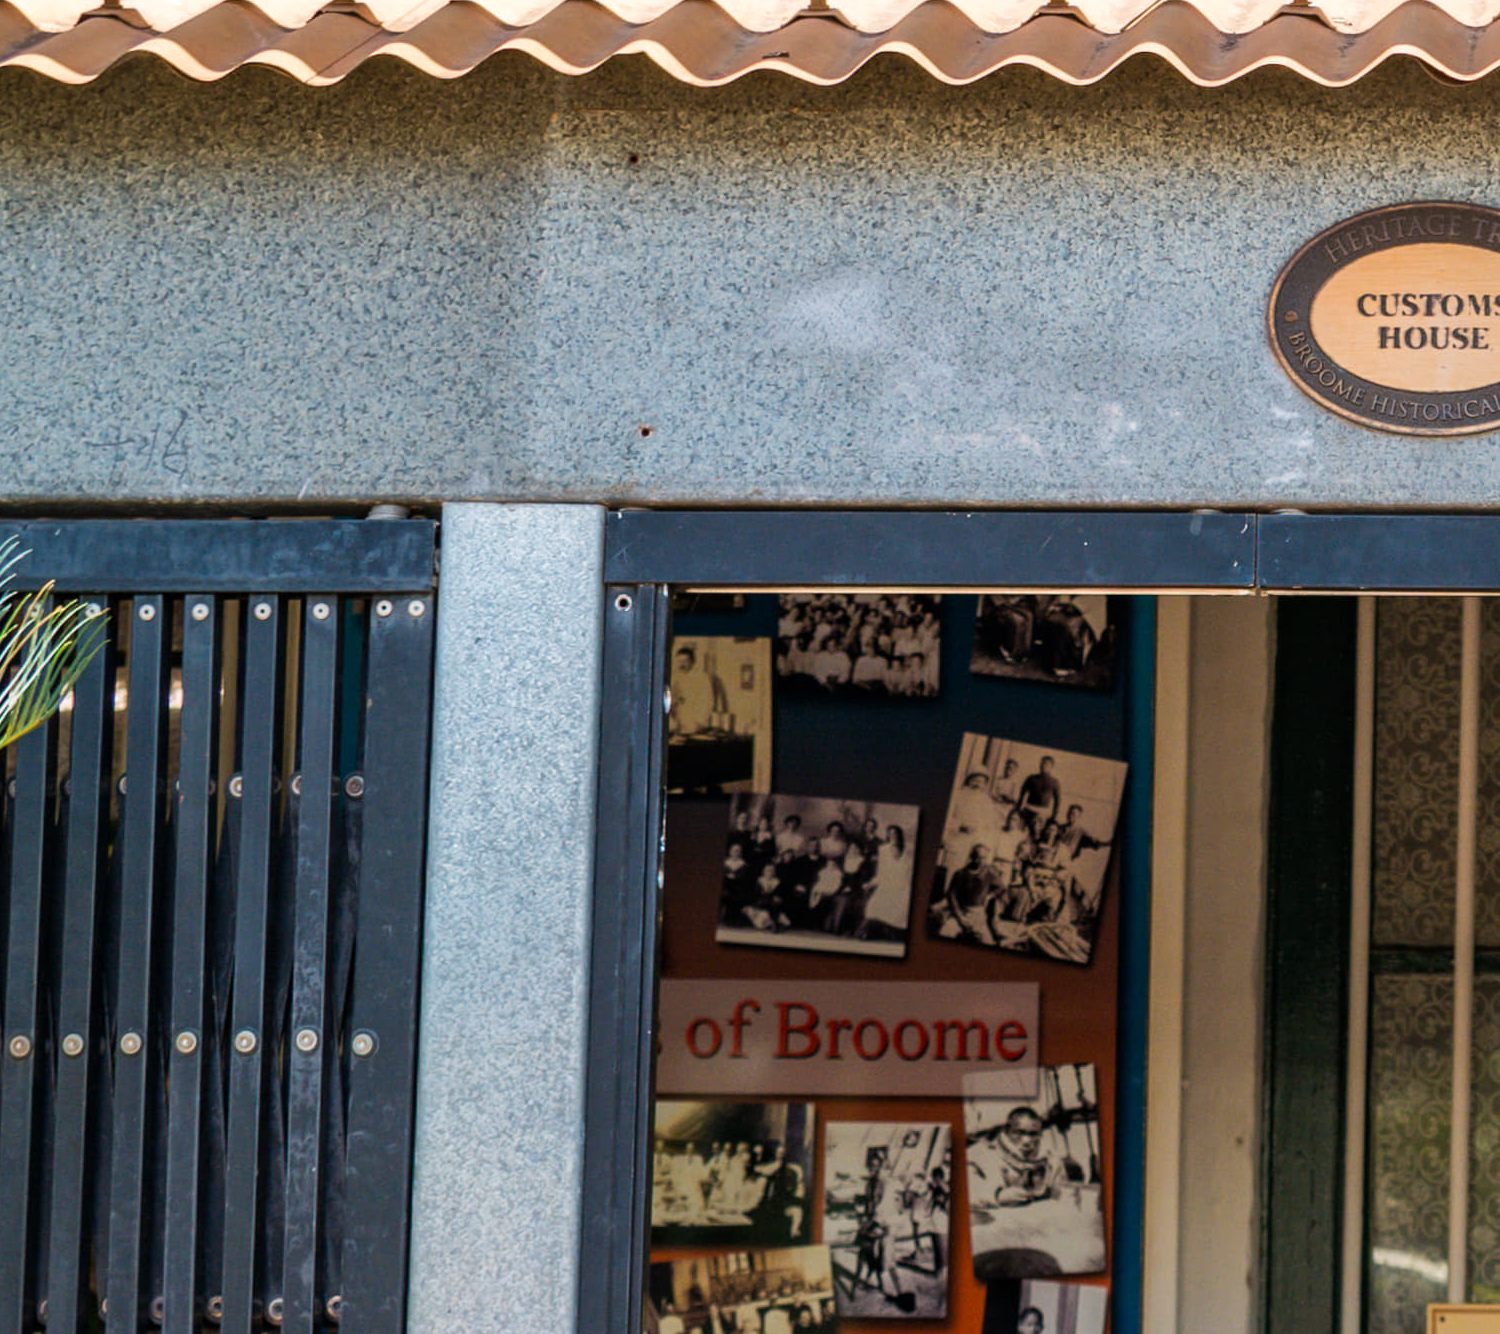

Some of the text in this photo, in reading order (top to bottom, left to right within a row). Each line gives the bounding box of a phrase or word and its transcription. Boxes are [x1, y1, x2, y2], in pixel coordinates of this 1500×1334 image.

[1324, 214, 1462, 264] HERITAGE
[1378, 325, 1491, 351] HOUSE
[1287, 330, 1367, 406] BROOME
[685, 998, 761, 1059] of
[773, 1000, 1028, 1062] Broome
